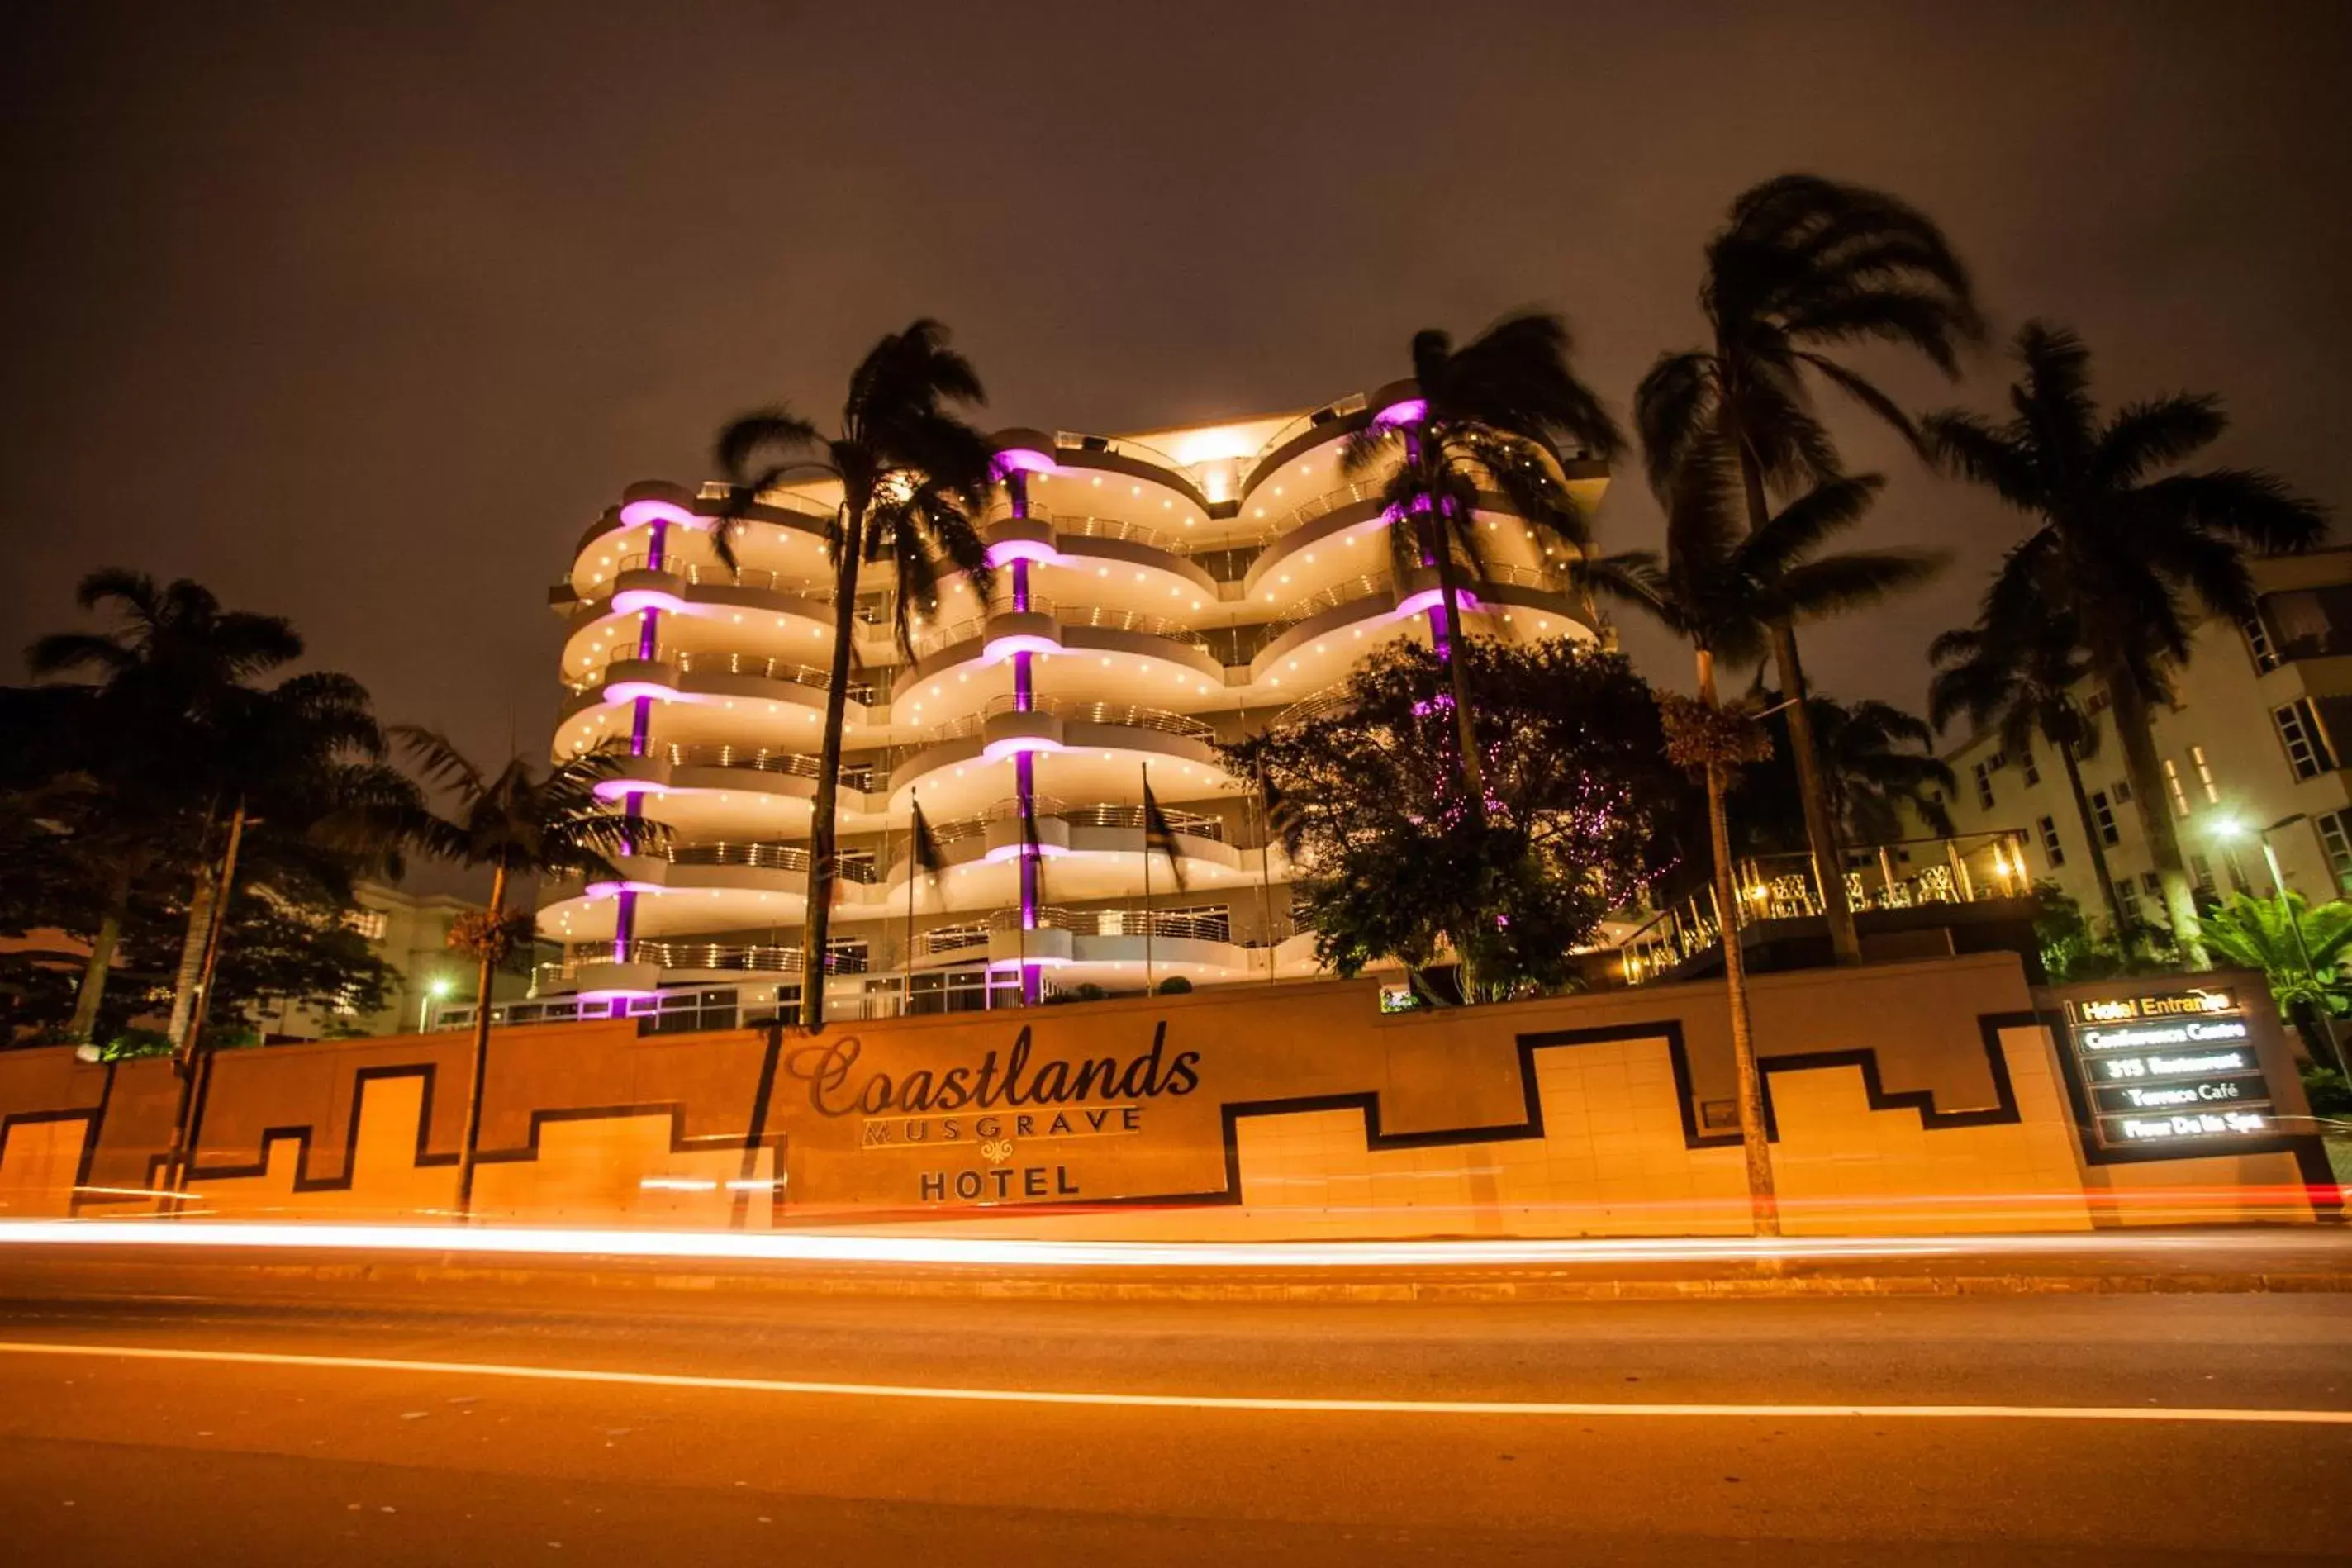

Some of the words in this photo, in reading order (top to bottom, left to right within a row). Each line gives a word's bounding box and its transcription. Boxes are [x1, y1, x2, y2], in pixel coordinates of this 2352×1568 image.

[2083, 1000, 2138, 1020] Hotel
[784, 1020, 1201, 1119] Coastlands
[2198, 1083, 2238, 1100] Café
[862, 1109, 1142, 1145] MUSGRAVE
[920, 1166, 1080, 1201] HOTEL
